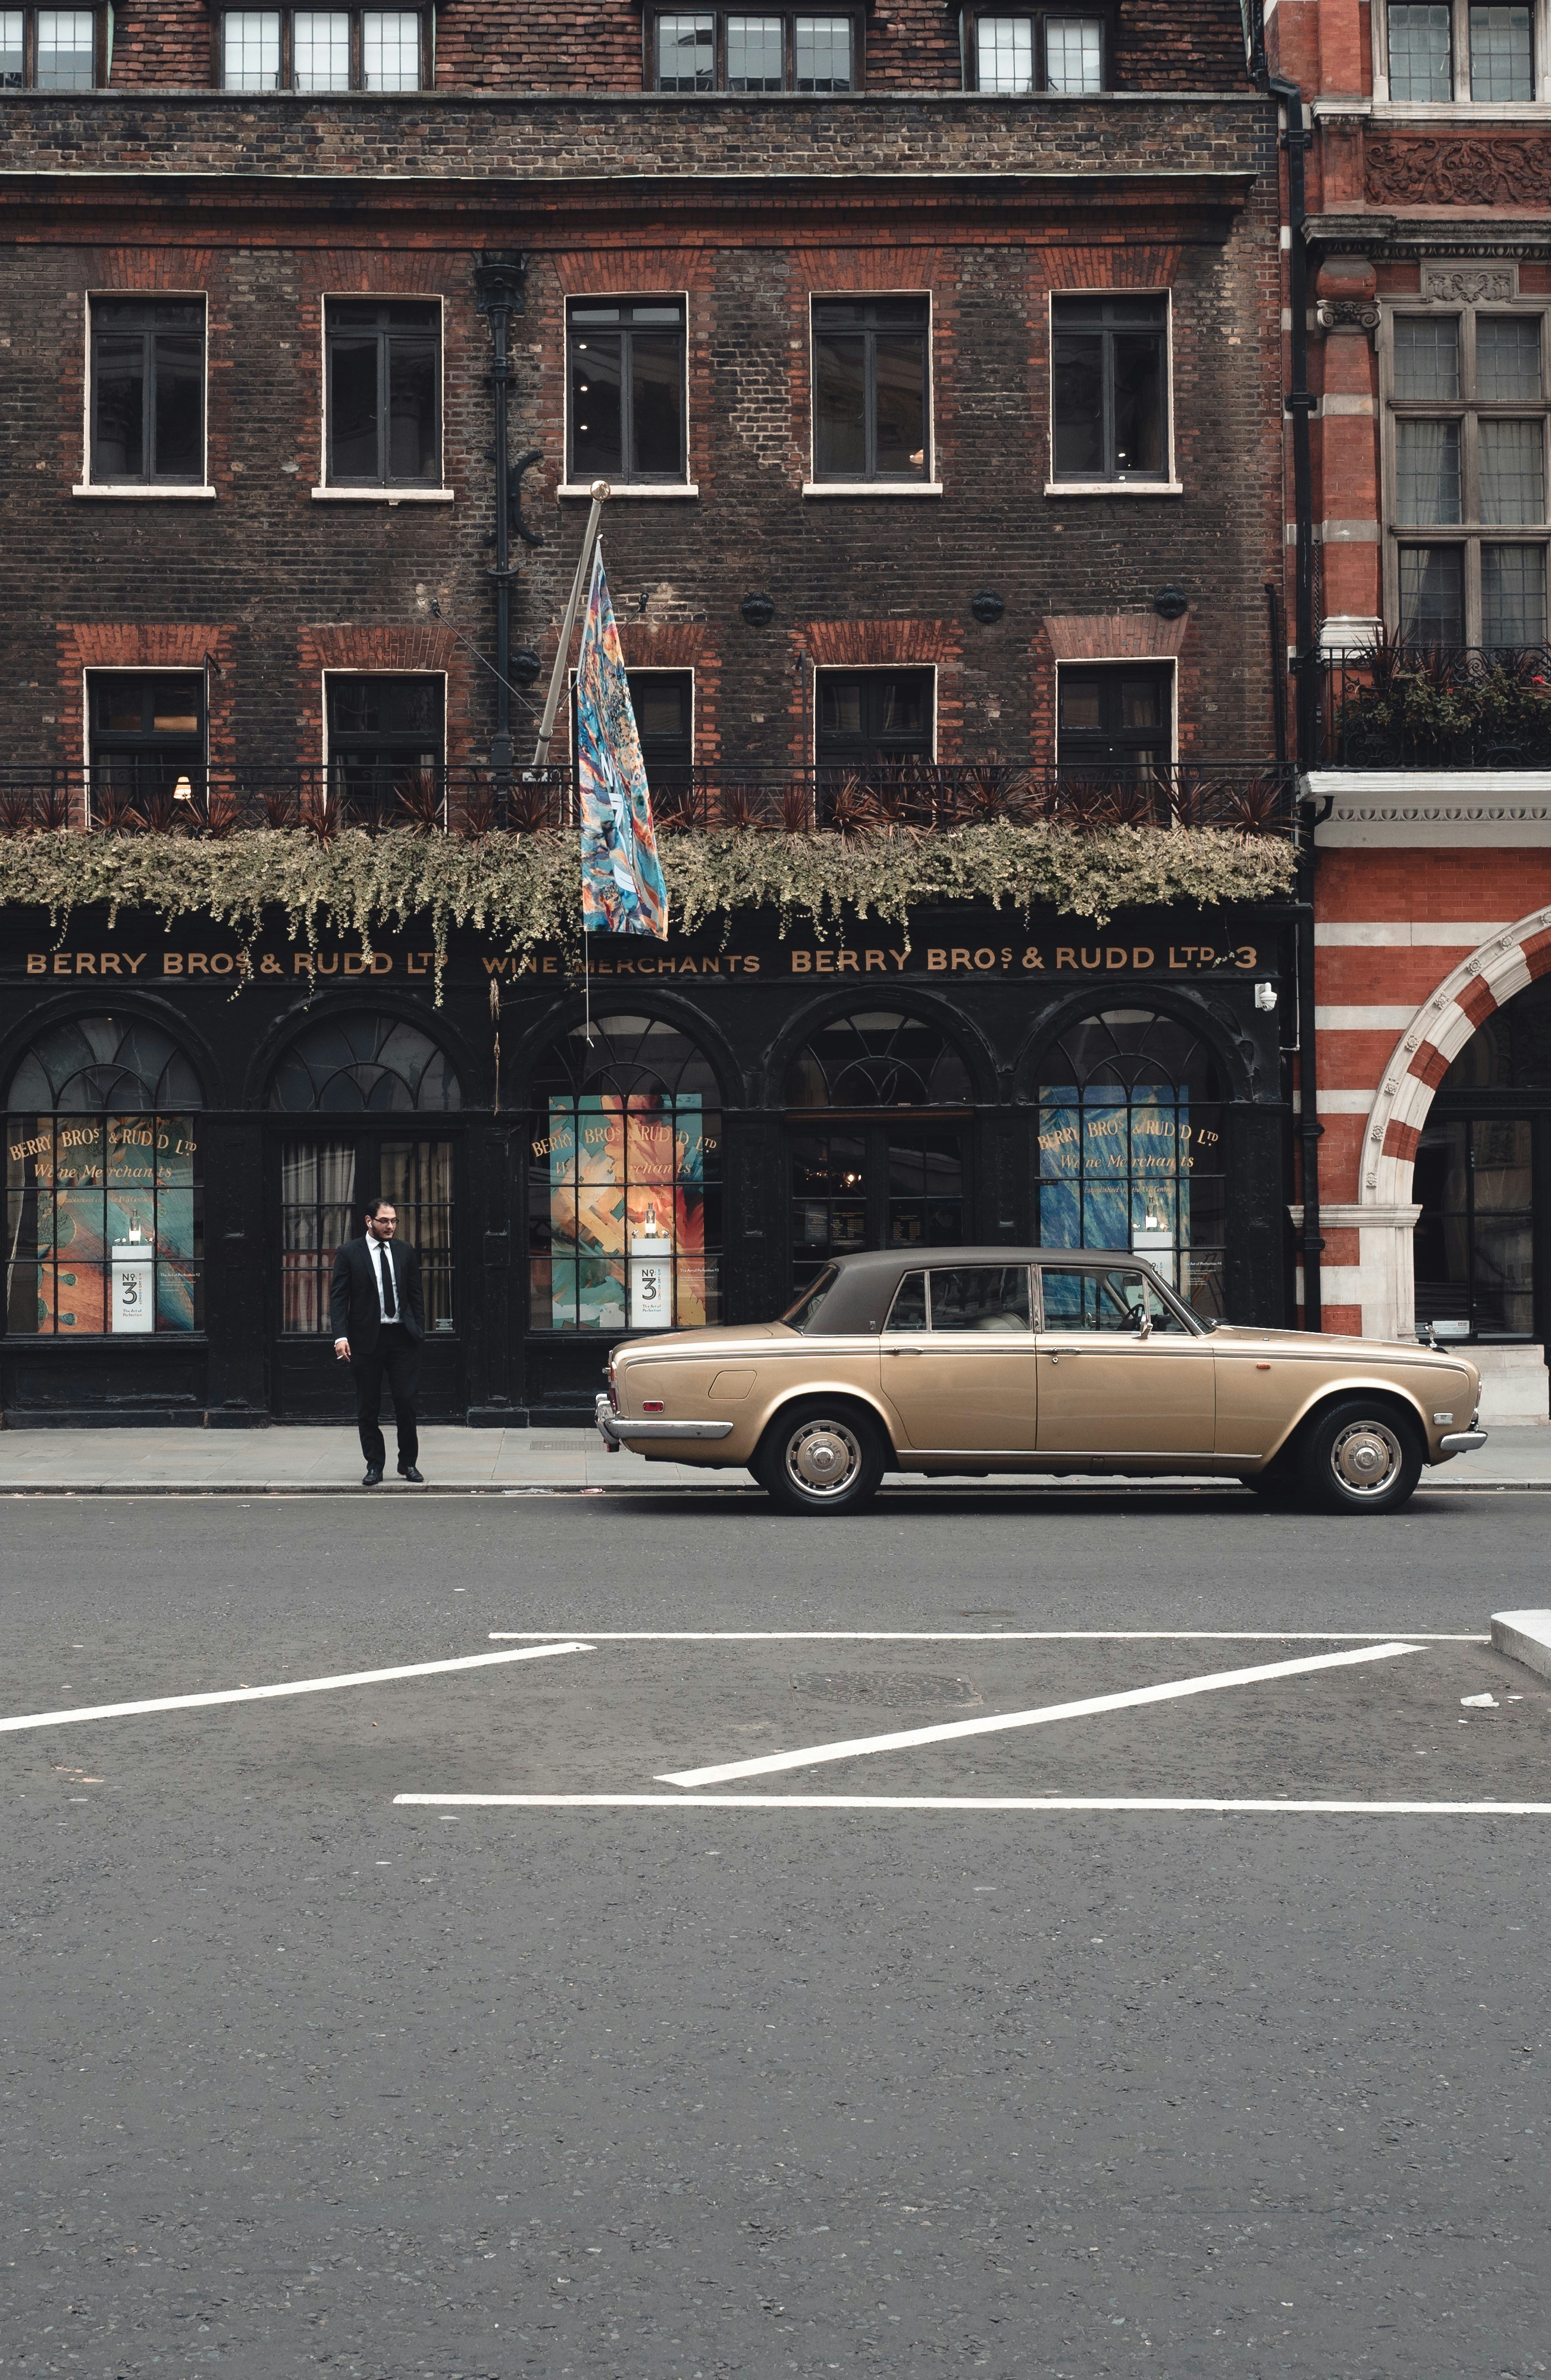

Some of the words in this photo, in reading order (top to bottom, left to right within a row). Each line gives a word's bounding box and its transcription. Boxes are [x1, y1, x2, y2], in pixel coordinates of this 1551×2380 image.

[27, 953, 147, 975] BERRY
[260, 953, 284, 974] &
[294, 953, 393, 975] RUDD
[481, 957, 557, 974] WINE
[575, 955, 760, 974] MERCHANTS
[792, 949, 911, 972] BERRY
[1022, 947, 1045, 969] &
[1056, 947, 1154, 969] RUDD
[1234, 946, 1257, 969] 3
[9, 1135, 52, 1161] BERRY
[108, 1132, 119, 1144] &
[123, 1128, 169, 1150] RUDD
[531, 1132, 573, 1158] BERRY
[640, 1125, 690, 1146] RUDD
[1037, 1126, 1080, 1150] BERRY
[1146, 1119, 1192, 1139] RUDD
[35, 1164, 76, 1179] Wine
[83, 1164, 173, 1179] Merchants
[1107, 1154, 1195, 1169] Merchants
[122, 1282, 137, 1305] 3
[642, 1277, 657, 1300] 3
